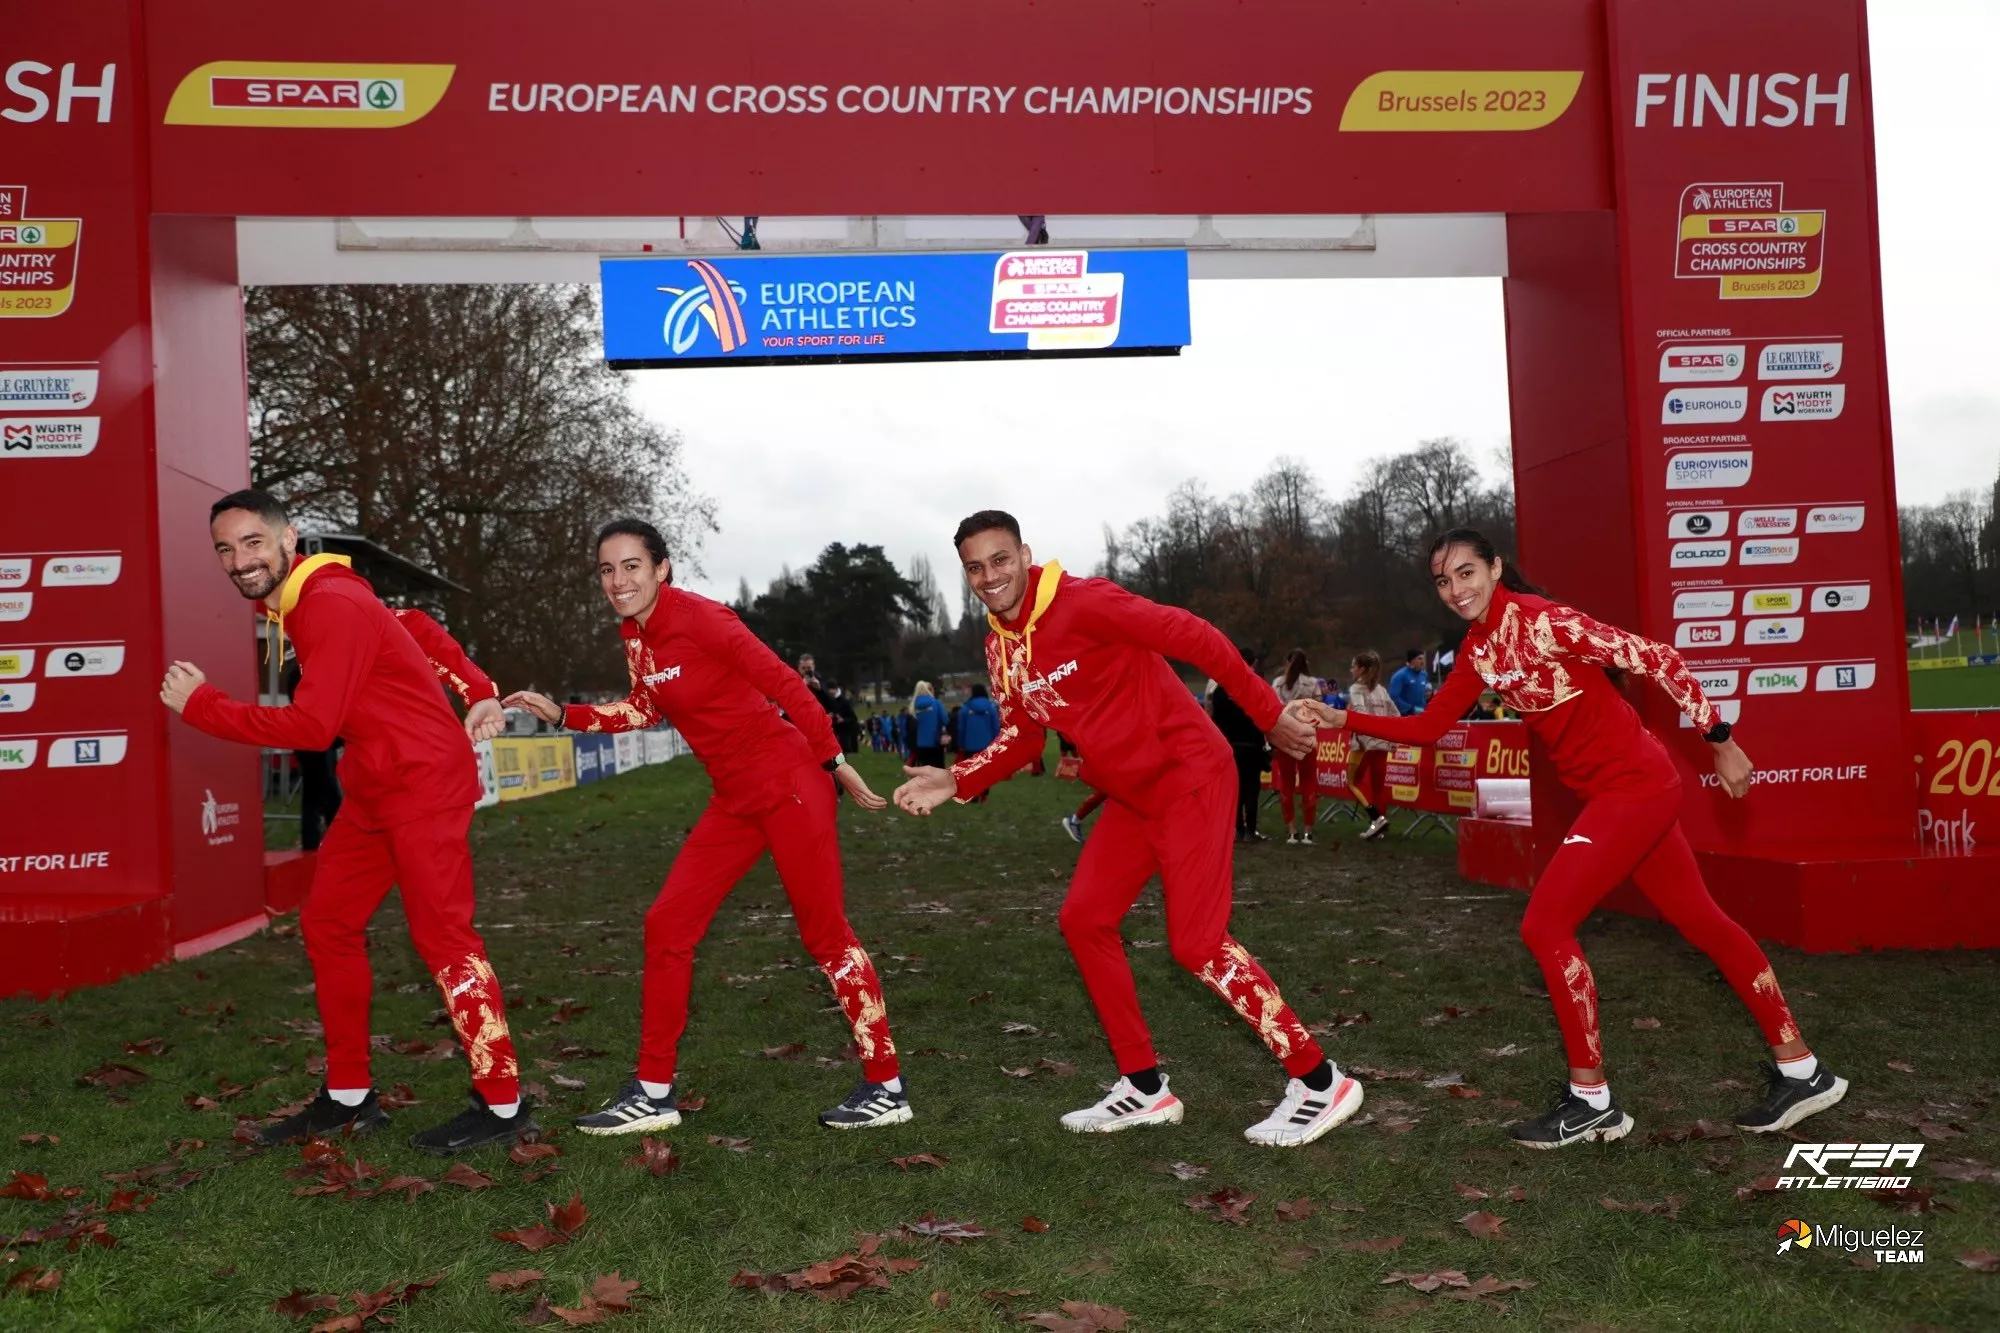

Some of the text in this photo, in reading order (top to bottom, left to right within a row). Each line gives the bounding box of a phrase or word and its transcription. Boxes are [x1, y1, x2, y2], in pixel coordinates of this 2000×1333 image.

[247, 84, 358, 103] SPAR
[488, 83, 1313, 114] EUROPEAN CROSS COUNTRY CHAMPIONSHIPS
[1635, 73, 1849, 127] FINISH
[1378, 89, 1546, 112] Brussels 2023
[1713, 188, 1772, 199] EUROPEAN
[1713, 199, 1773, 209] ATHLETICS
[1724, 220, 1777, 232] SPAR
[1692, 241, 1807, 256] CROSS COUNTRY
[1691, 257, 1806, 271] CHAMPIONSHIPS
[1732, 280, 1806, 291] Brussels 2023
[761, 281, 915, 305] EUROPEAN
[15, 297, 52, 309] 2023
[1005, 300, 1107, 313] CROSS COUNTRY
[761, 306, 917, 331] ATHLETICS
[1004, 313, 1105, 325] CHAMPIONSHIPS
[1656, 328, 1731, 338] OFFICIAL PARTNERS
[763, 335, 885, 347] YOUR SPORT FOR LIFE
[1681, 356, 1723, 366] SPAR
[1766, 349, 1822, 364] LE GRUYÈRE
[14, 377, 70, 392] GRUYÈRE
[1685, 400, 1742, 411] EUROHOLD
[36, 434, 82, 443] MODYF
[1663, 435, 1747, 444] BROADCAST PARTNER
[1676, 470, 1713, 481] SPORT
[1675, 549, 1726, 559] GOLAZO
[1691, 628, 1720, 641] lotto
[1021, 660, 1078, 694] ESPAÑA
[1802, 767, 1834, 782] FOR
[1837, 765, 1868, 780] LIFE
[24, 854, 65, 871] FOR
[69, 852, 110, 869] LIFE
